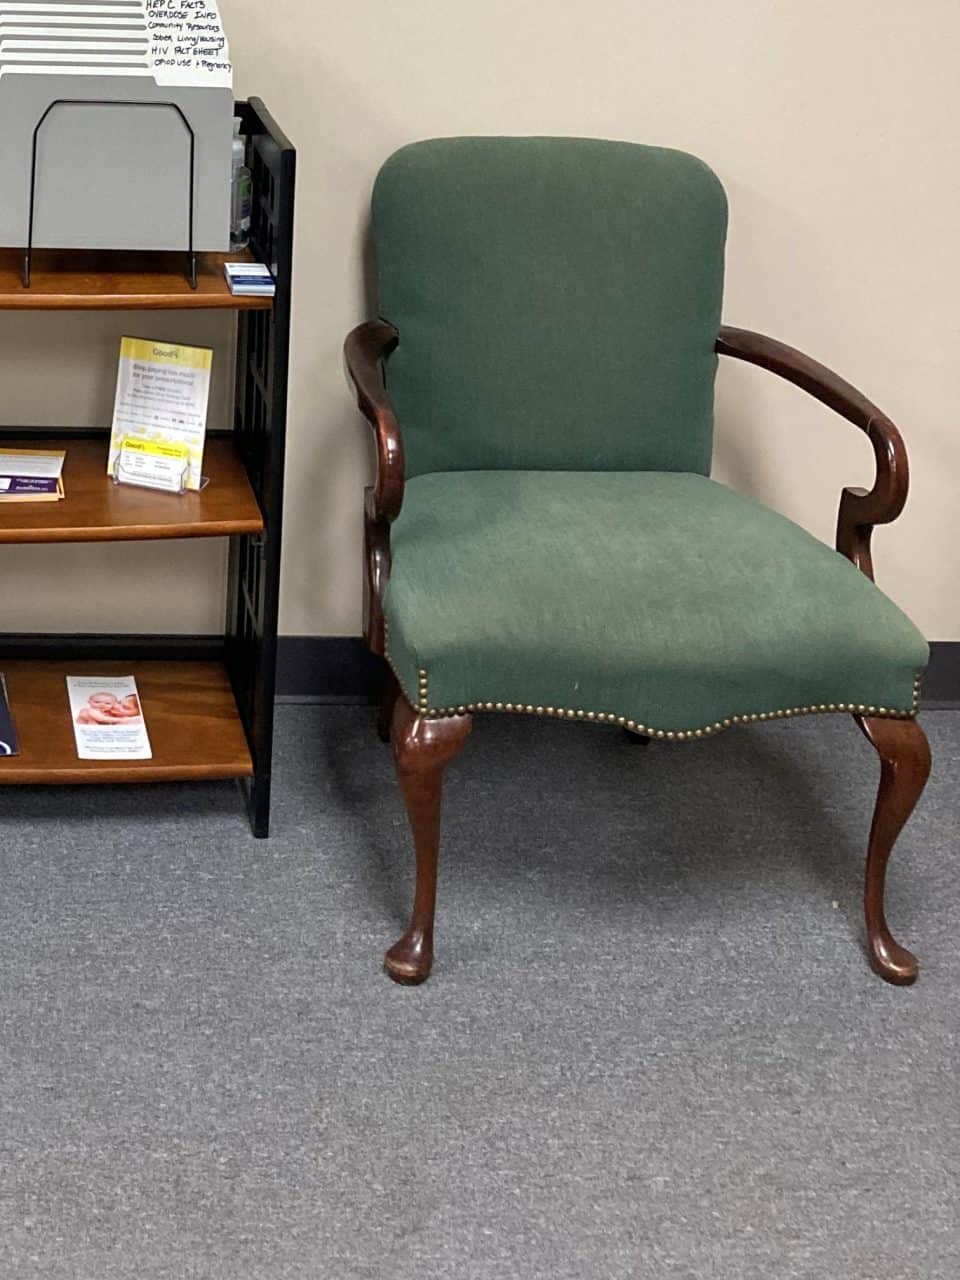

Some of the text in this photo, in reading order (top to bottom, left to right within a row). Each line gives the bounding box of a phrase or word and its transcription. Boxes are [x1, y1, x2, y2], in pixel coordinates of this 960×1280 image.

[145, 0, 206, 10] HEP C FACTS
[147, 10, 217, 20] OVERDOSE INFO
[147, 21, 184, 31] Community
[151, 46, 169, 55] HIV
[174, 46, 192, 55] FACT
